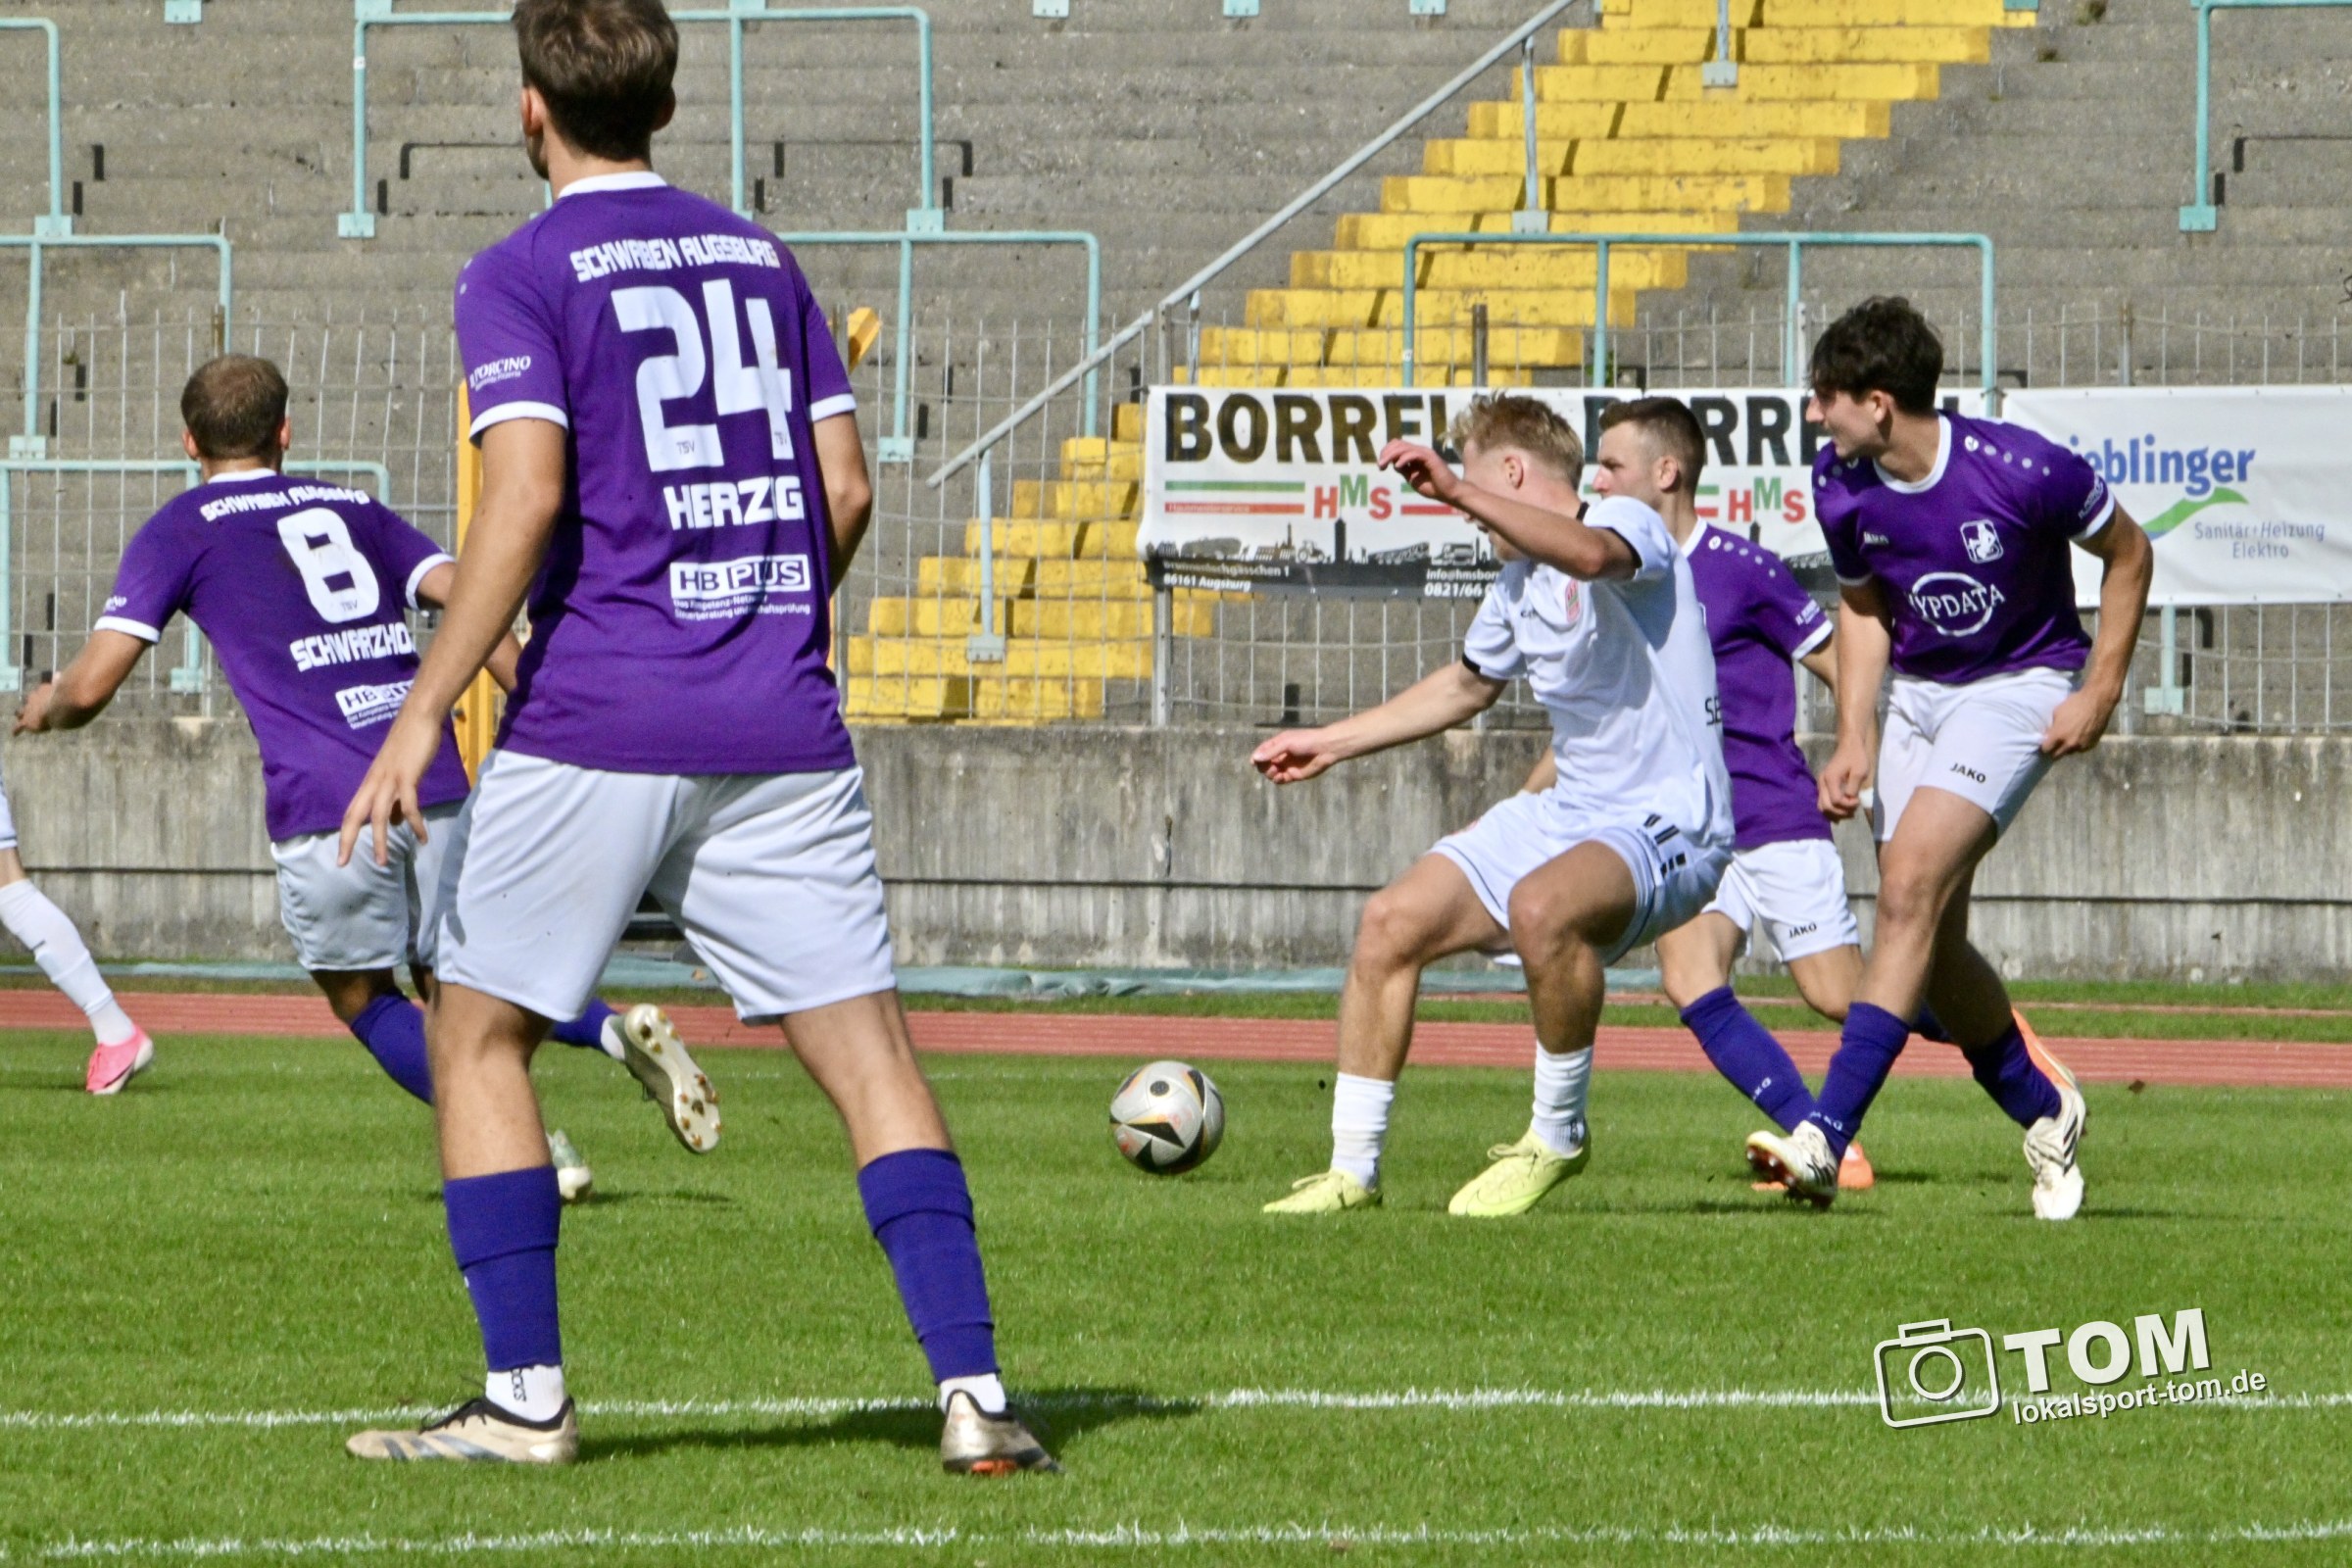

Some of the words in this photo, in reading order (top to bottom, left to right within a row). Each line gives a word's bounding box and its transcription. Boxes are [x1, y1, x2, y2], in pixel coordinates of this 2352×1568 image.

[569, 238, 683, 283] SCHWABEN
[678, 233, 781, 270] AUGSBURG
[611, 277, 794, 470] 24
[1165, 392, 1482, 465] BORREL
[662, 475, 805, 530] HERZG
[1313, 473, 1393, 520] HMS
[1728, 476, 1806, 523] HMS
[276, 507, 379, 623] 8
[2232, 541, 2289, 560] Elektro
[679, 569, 720, 591] HB
[1199, 576, 1251, 592] Augsburg
[1909, 584, 2005, 619] YPDATA
[289, 621, 416, 672] SCHWARZHO
[1950, 762, 1986, 784] JAKO
[1789, 922, 1817, 938] JAKO
